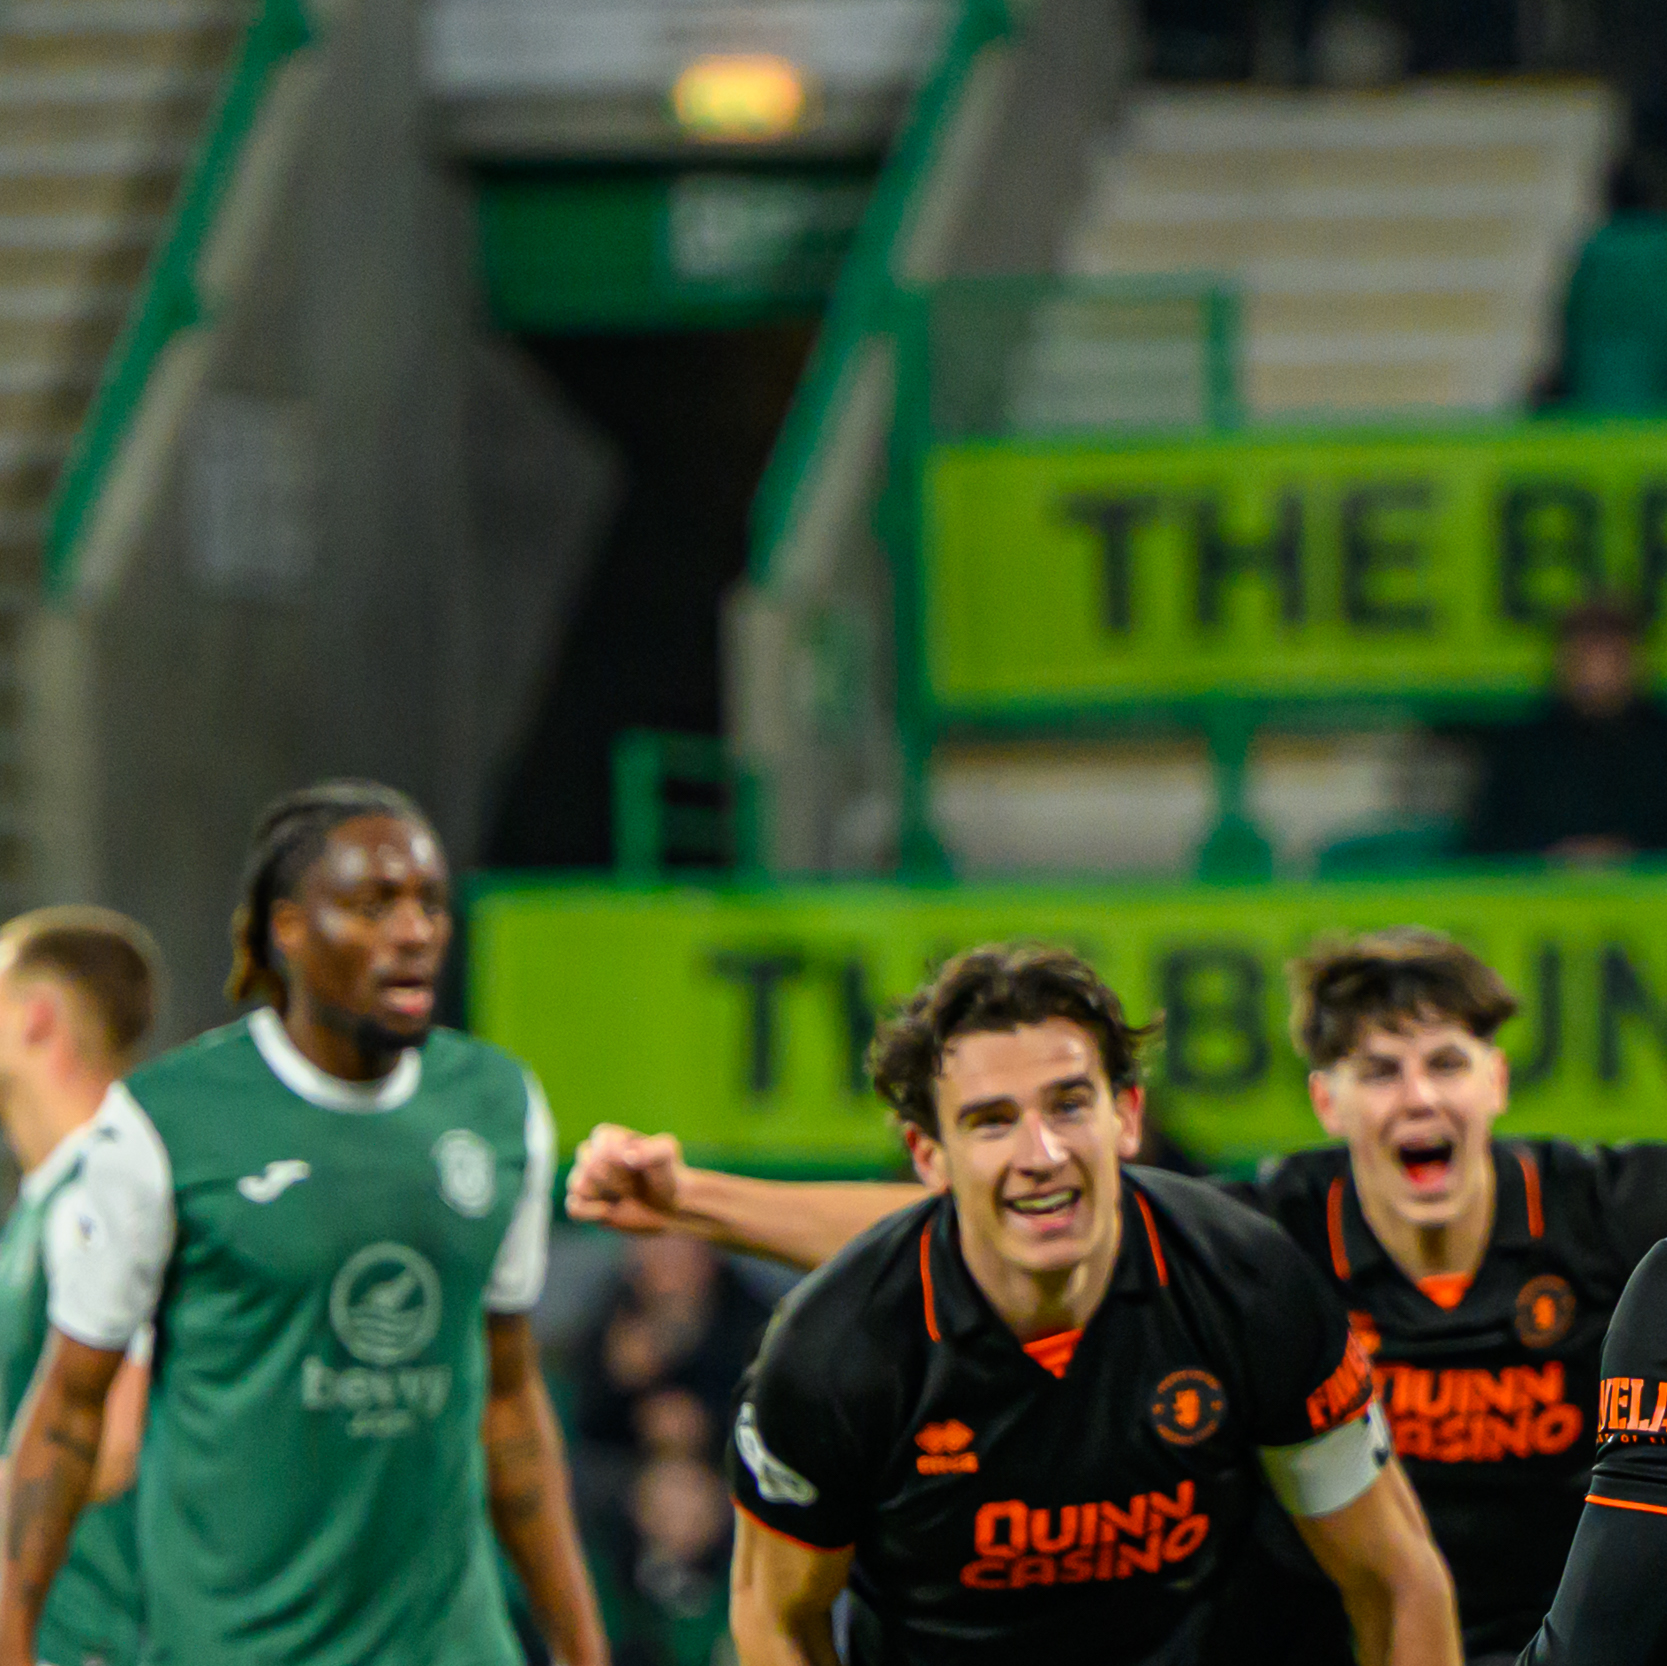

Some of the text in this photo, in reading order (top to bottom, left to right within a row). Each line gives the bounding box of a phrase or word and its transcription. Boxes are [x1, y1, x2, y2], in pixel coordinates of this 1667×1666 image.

[1056, 478, 1442, 638] THE
[959, 1513, 1209, 1589] CASINO
[972, 1478, 1196, 1558] QUINN
